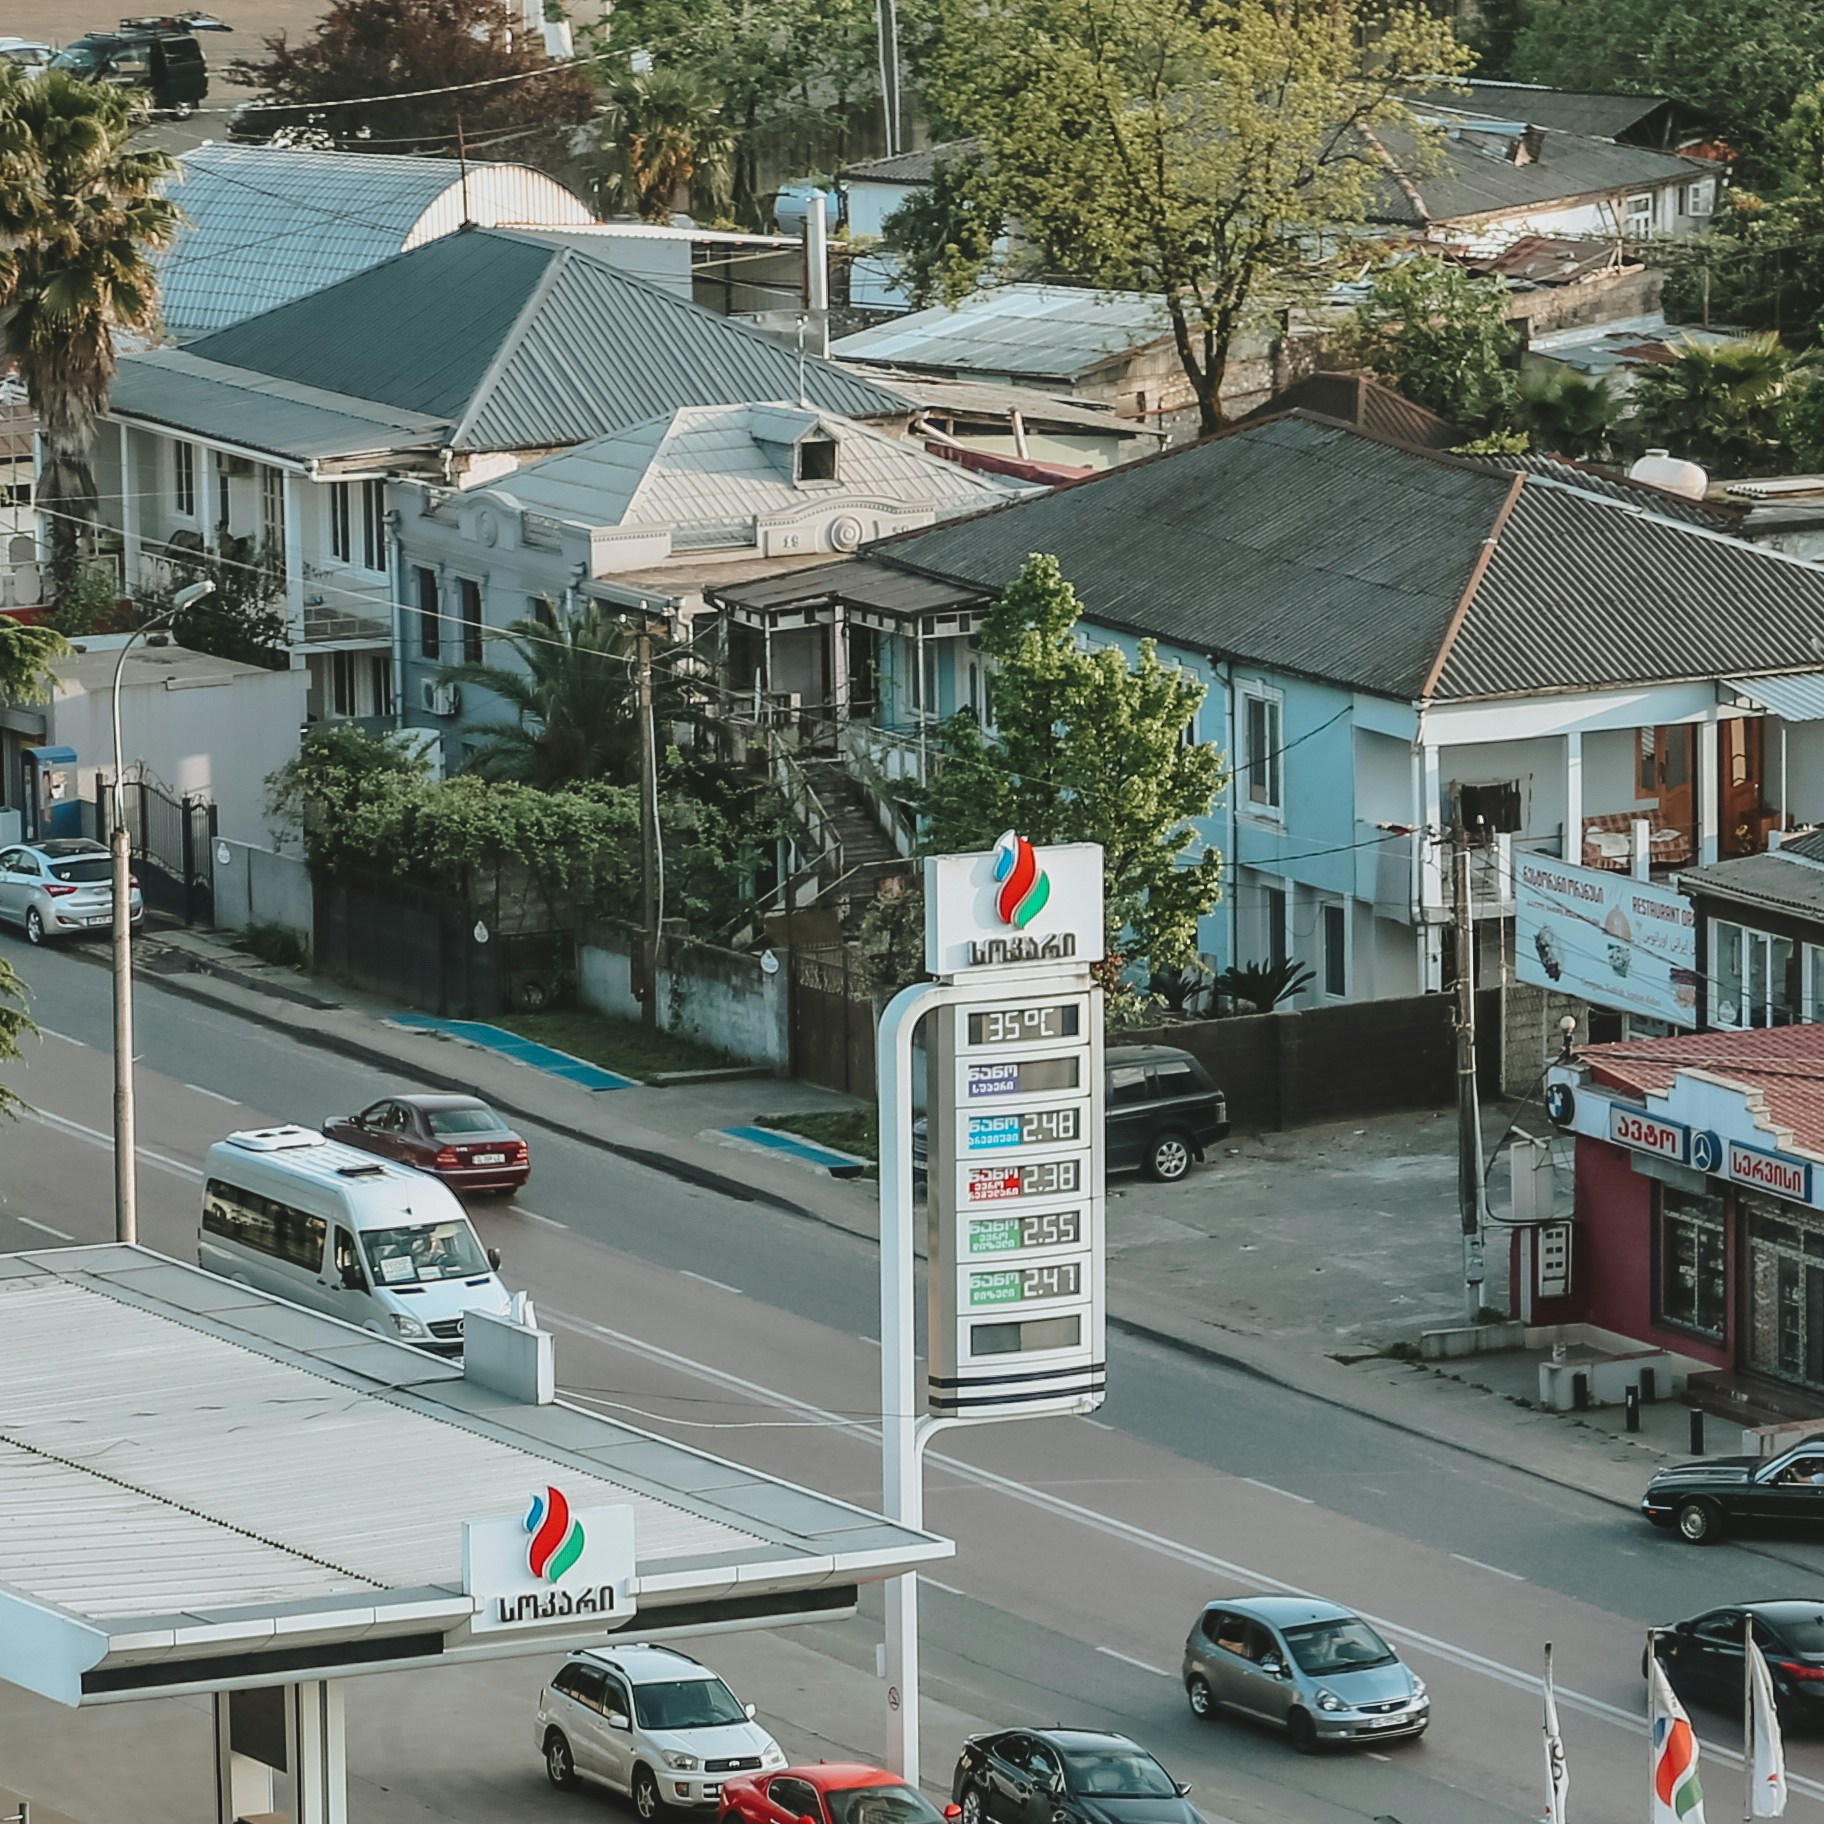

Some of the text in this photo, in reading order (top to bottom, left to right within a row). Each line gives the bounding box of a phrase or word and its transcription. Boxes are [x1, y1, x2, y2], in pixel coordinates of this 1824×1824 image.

[967, 932, 1076, 966] სოკარი
[969, 1065, 1018, 1081] ნანო
[969, 1116, 1018, 1132] ნანო
[1023, 1110, 1074, 1141] 2.48
[1617, 1116, 1802, 1194] ავტო სერვისი
[1023, 1162, 1074, 1193] 2.38
[1023, 1213, 1074, 1245] 2.55
[969, 1272, 1019, 1287] ნანო
[1023, 1265, 1074, 1297] 2.47
[499, 1585, 615, 1624] სოკარი
